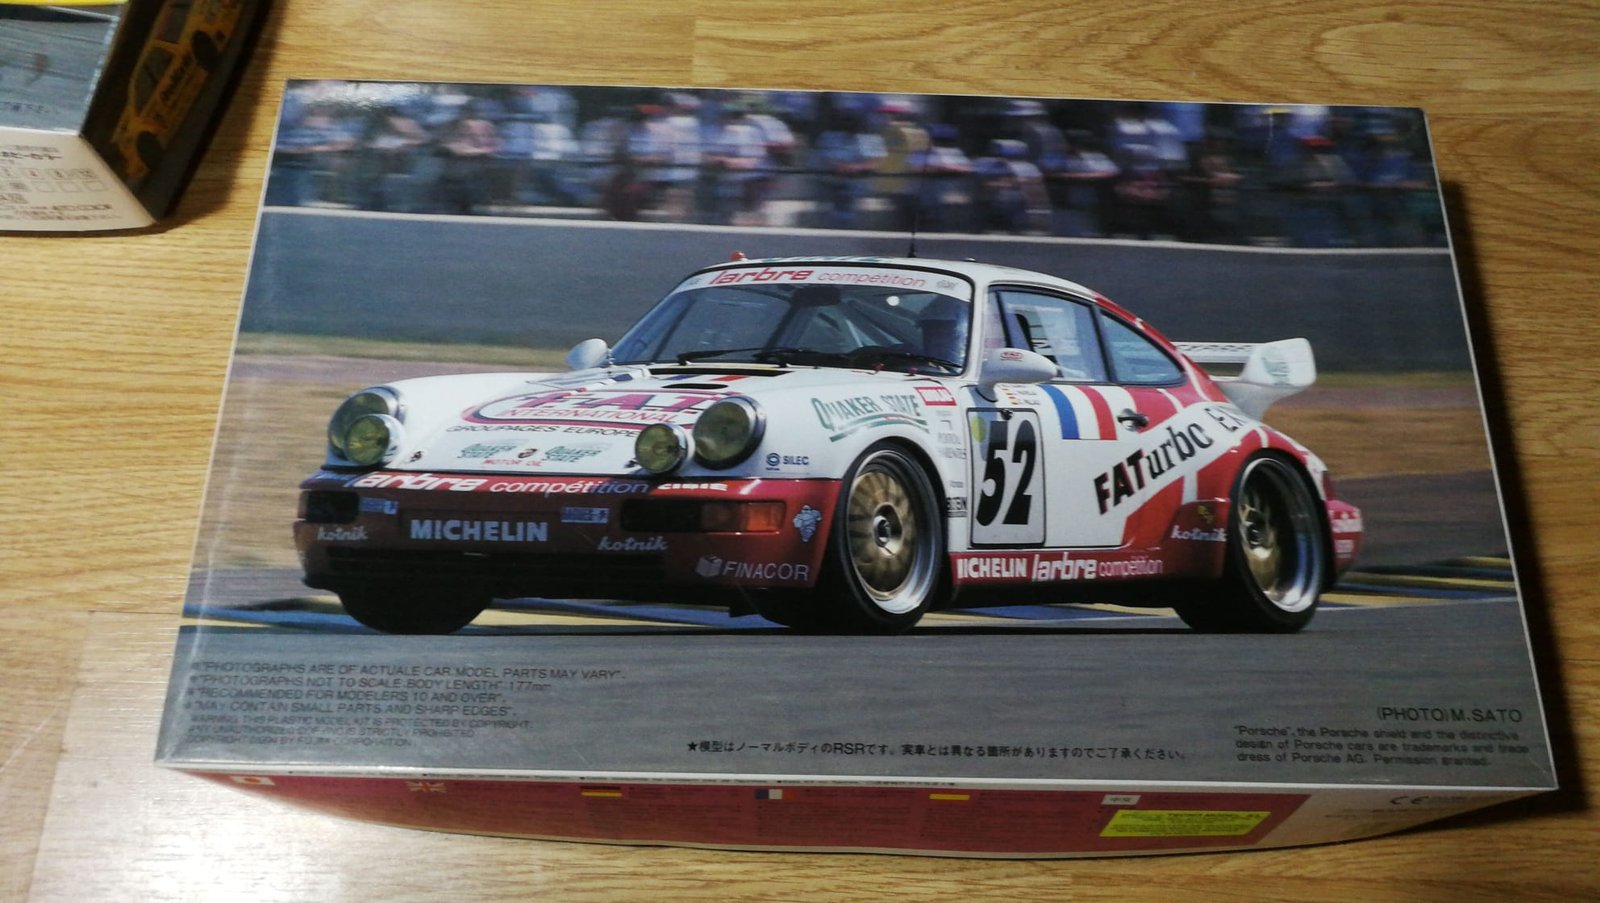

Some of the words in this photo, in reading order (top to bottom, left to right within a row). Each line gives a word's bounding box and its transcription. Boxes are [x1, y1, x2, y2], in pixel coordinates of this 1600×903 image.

[709, 267, 814, 285] larbre
[502, 407, 678, 425] INTERNATIONAL
[445, 423, 560, 434] GROUPAGES
[783, 455, 810, 467] SILEC
[976, 419, 1037, 527] 52
[410, 519, 549, 542] MICHELIN
[597, 535, 670, 552] kotnik
[722, 560, 810, 582] FINACOR
[1032, 553, 1097, 582] larbre
[310, 663, 336, 675] ARE
[338, 664, 357, 675] OF
[360, 664, 420, 676] ACTUALE
[503, 667, 547, 679] PARTS
[550, 669, 578, 679] MAY
[306, 676, 333, 687] NOT
[338, 677, 356, 688] TO
[305, 688, 334, 700] FOR
[337, 690, 408, 701] MODELERS
[413, 691, 428, 702] 10
[431, 692, 458, 703] AND
[229, 701, 288, 712] CONTAIN
[290, 702, 333, 713] SMALL
[337, 703, 382, 714] PARTS
[385, 704, 412, 715] AND
[415, 704, 460, 715] SHARP
[1297, 727, 1316, 737] the
[1320, 726, 1369, 738] Porsche
[1373, 729, 1407, 739] shield
[1410, 731, 1432, 740] and
[1436, 730, 1455, 740] the
[1459, 730, 1519, 741] distinctive
[1235, 740, 1273, 750] design
[1277, 739, 1289, 750] of
[1294, 739, 1343, 750] Porsche
[1347, 742, 1374, 751] cars
[1378, 743, 1398, 752] are
[1402, 743, 1468, 753] trademarks
[1472, 744, 1494, 753] and
[1236, 752, 1271, 763] dress
[1275, 751, 1287, 762] of
[1291, 752, 1342, 763] Porsche
[1373, 753, 1438, 766] Permission
